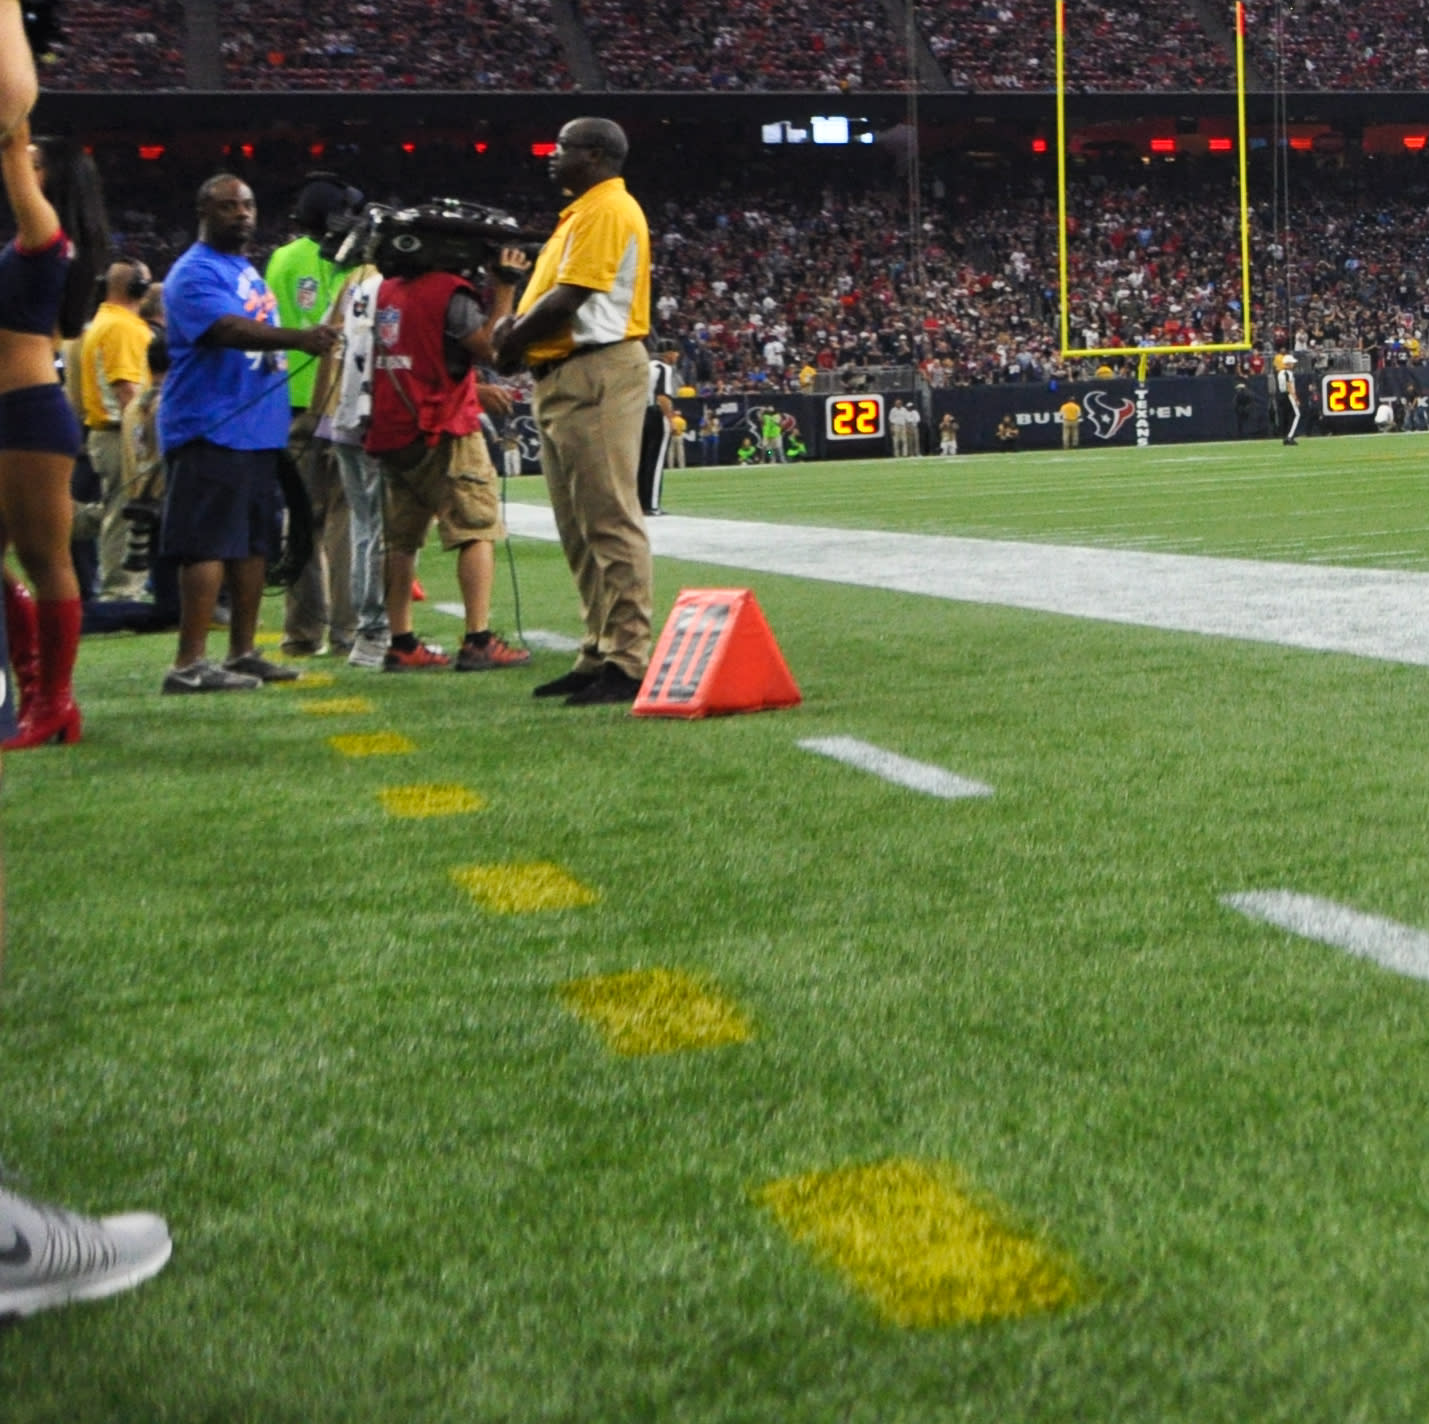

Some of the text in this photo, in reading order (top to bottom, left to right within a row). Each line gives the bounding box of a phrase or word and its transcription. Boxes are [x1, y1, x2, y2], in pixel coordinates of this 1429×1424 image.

[1149, 405, 1193, 419] EN
[1329, 379, 1367, 412] 22
[834, 401, 876, 434] 22
[1135, 389, 1149, 447] TEXANS
